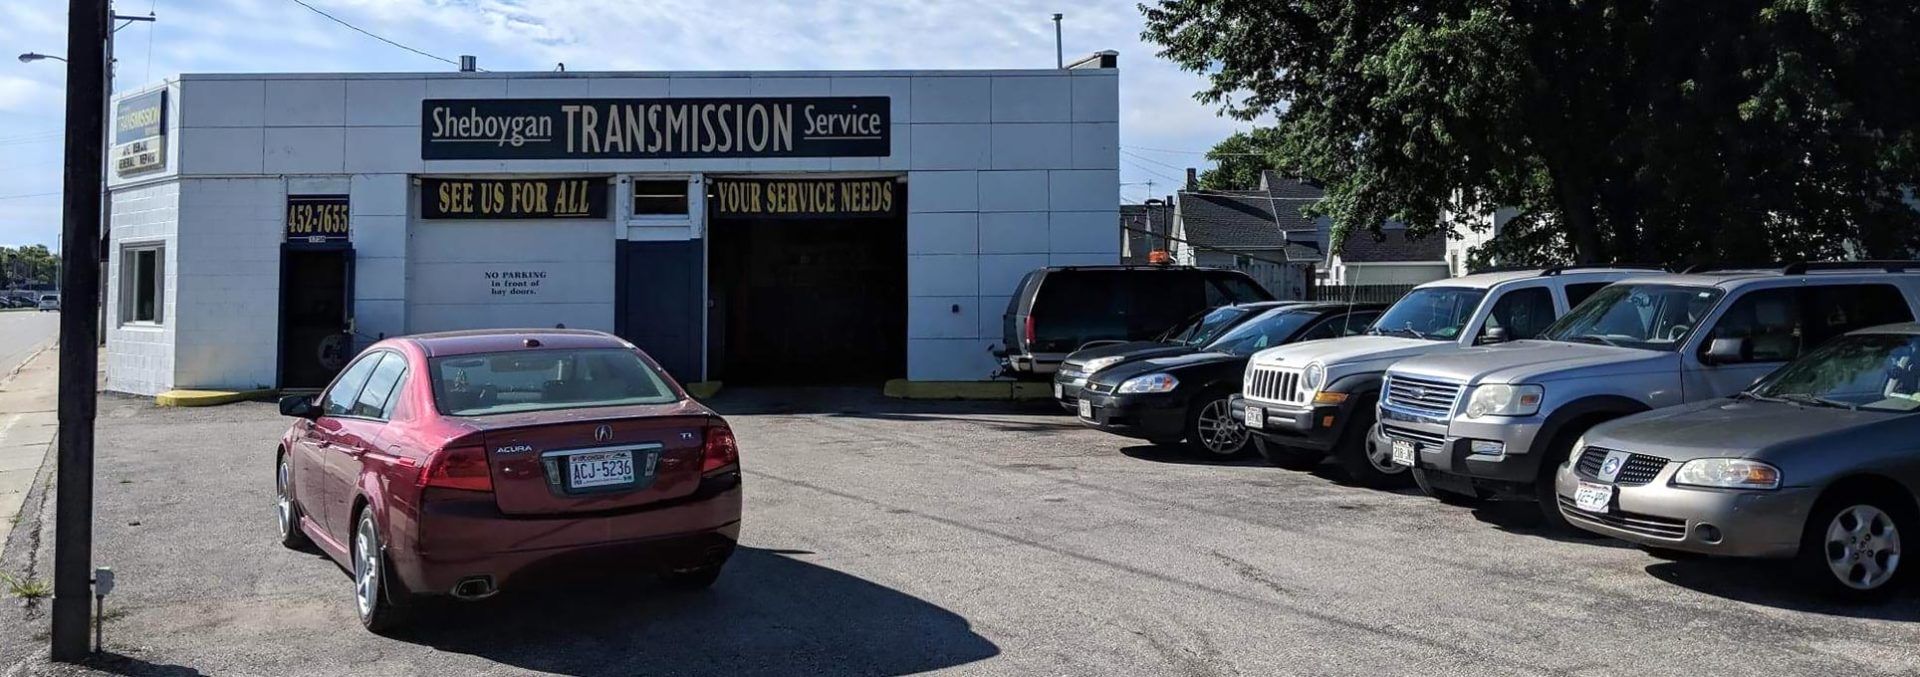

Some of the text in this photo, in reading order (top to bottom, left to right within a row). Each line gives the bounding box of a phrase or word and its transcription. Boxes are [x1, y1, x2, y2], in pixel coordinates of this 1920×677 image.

[432, 104, 881, 153] Sheboygan TRANSMISSION Service
[439, 180, 590, 214] SEE US FOR ALL
[717, 181, 892, 213] YOUR SERVICE NEEDS
[289, 204, 348, 233] 452-7655
[485, 271, 547, 279] NO PARKING
[491, 288, 506, 297] bay
[496, 445, 532, 454] ACURA
[574, 460, 632, 480] ACJ-5236
